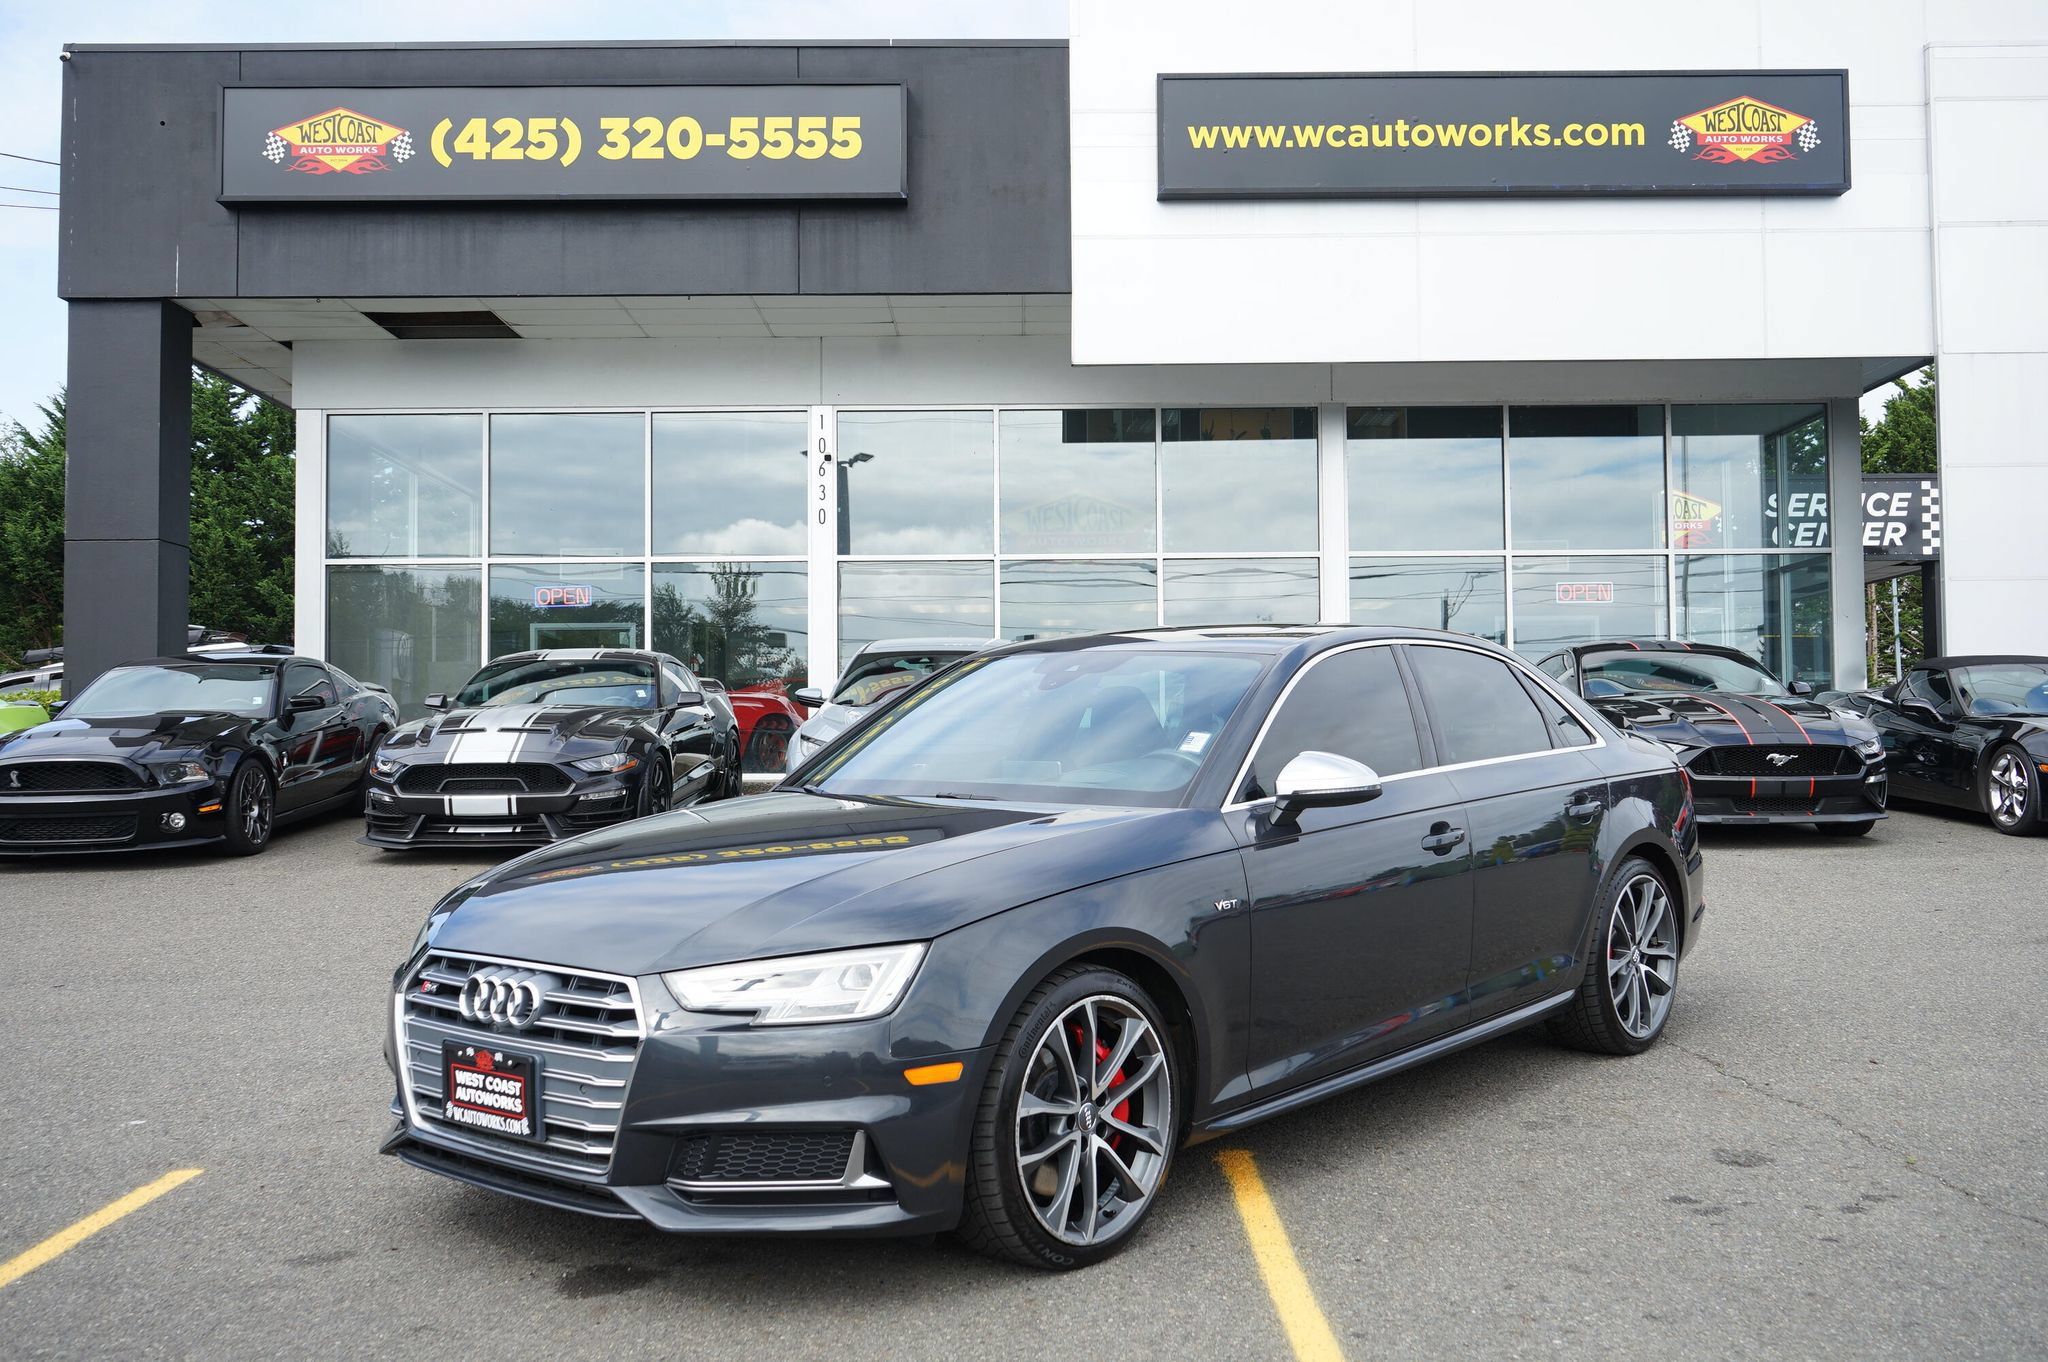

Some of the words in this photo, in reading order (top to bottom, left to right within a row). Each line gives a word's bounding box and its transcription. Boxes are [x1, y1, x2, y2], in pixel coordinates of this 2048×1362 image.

[430, 117, 582, 168] (425)
[597, 116, 863, 161] 320-5555
[1187, 117, 1646, 149] www.wcautoworks.com
[1704, 135, 1738, 143] AUTO
[1740, 135, 1784, 143] WORKS
[299, 146, 333, 154] AUTO
[335, 146, 378, 154] WORKS
[537, 587, 589, 605] OPEN
[1559, 584, 1611, 601] OPEN
[1214, 899, 1238, 911] V6T
[1019, 1008, 1051, 1059] Continental
[454, 1069, 486, 1089] WEST
[485, 1076, 523, 1096] COAST
[455, 1086, 524, 1113] AUTOWORKS
